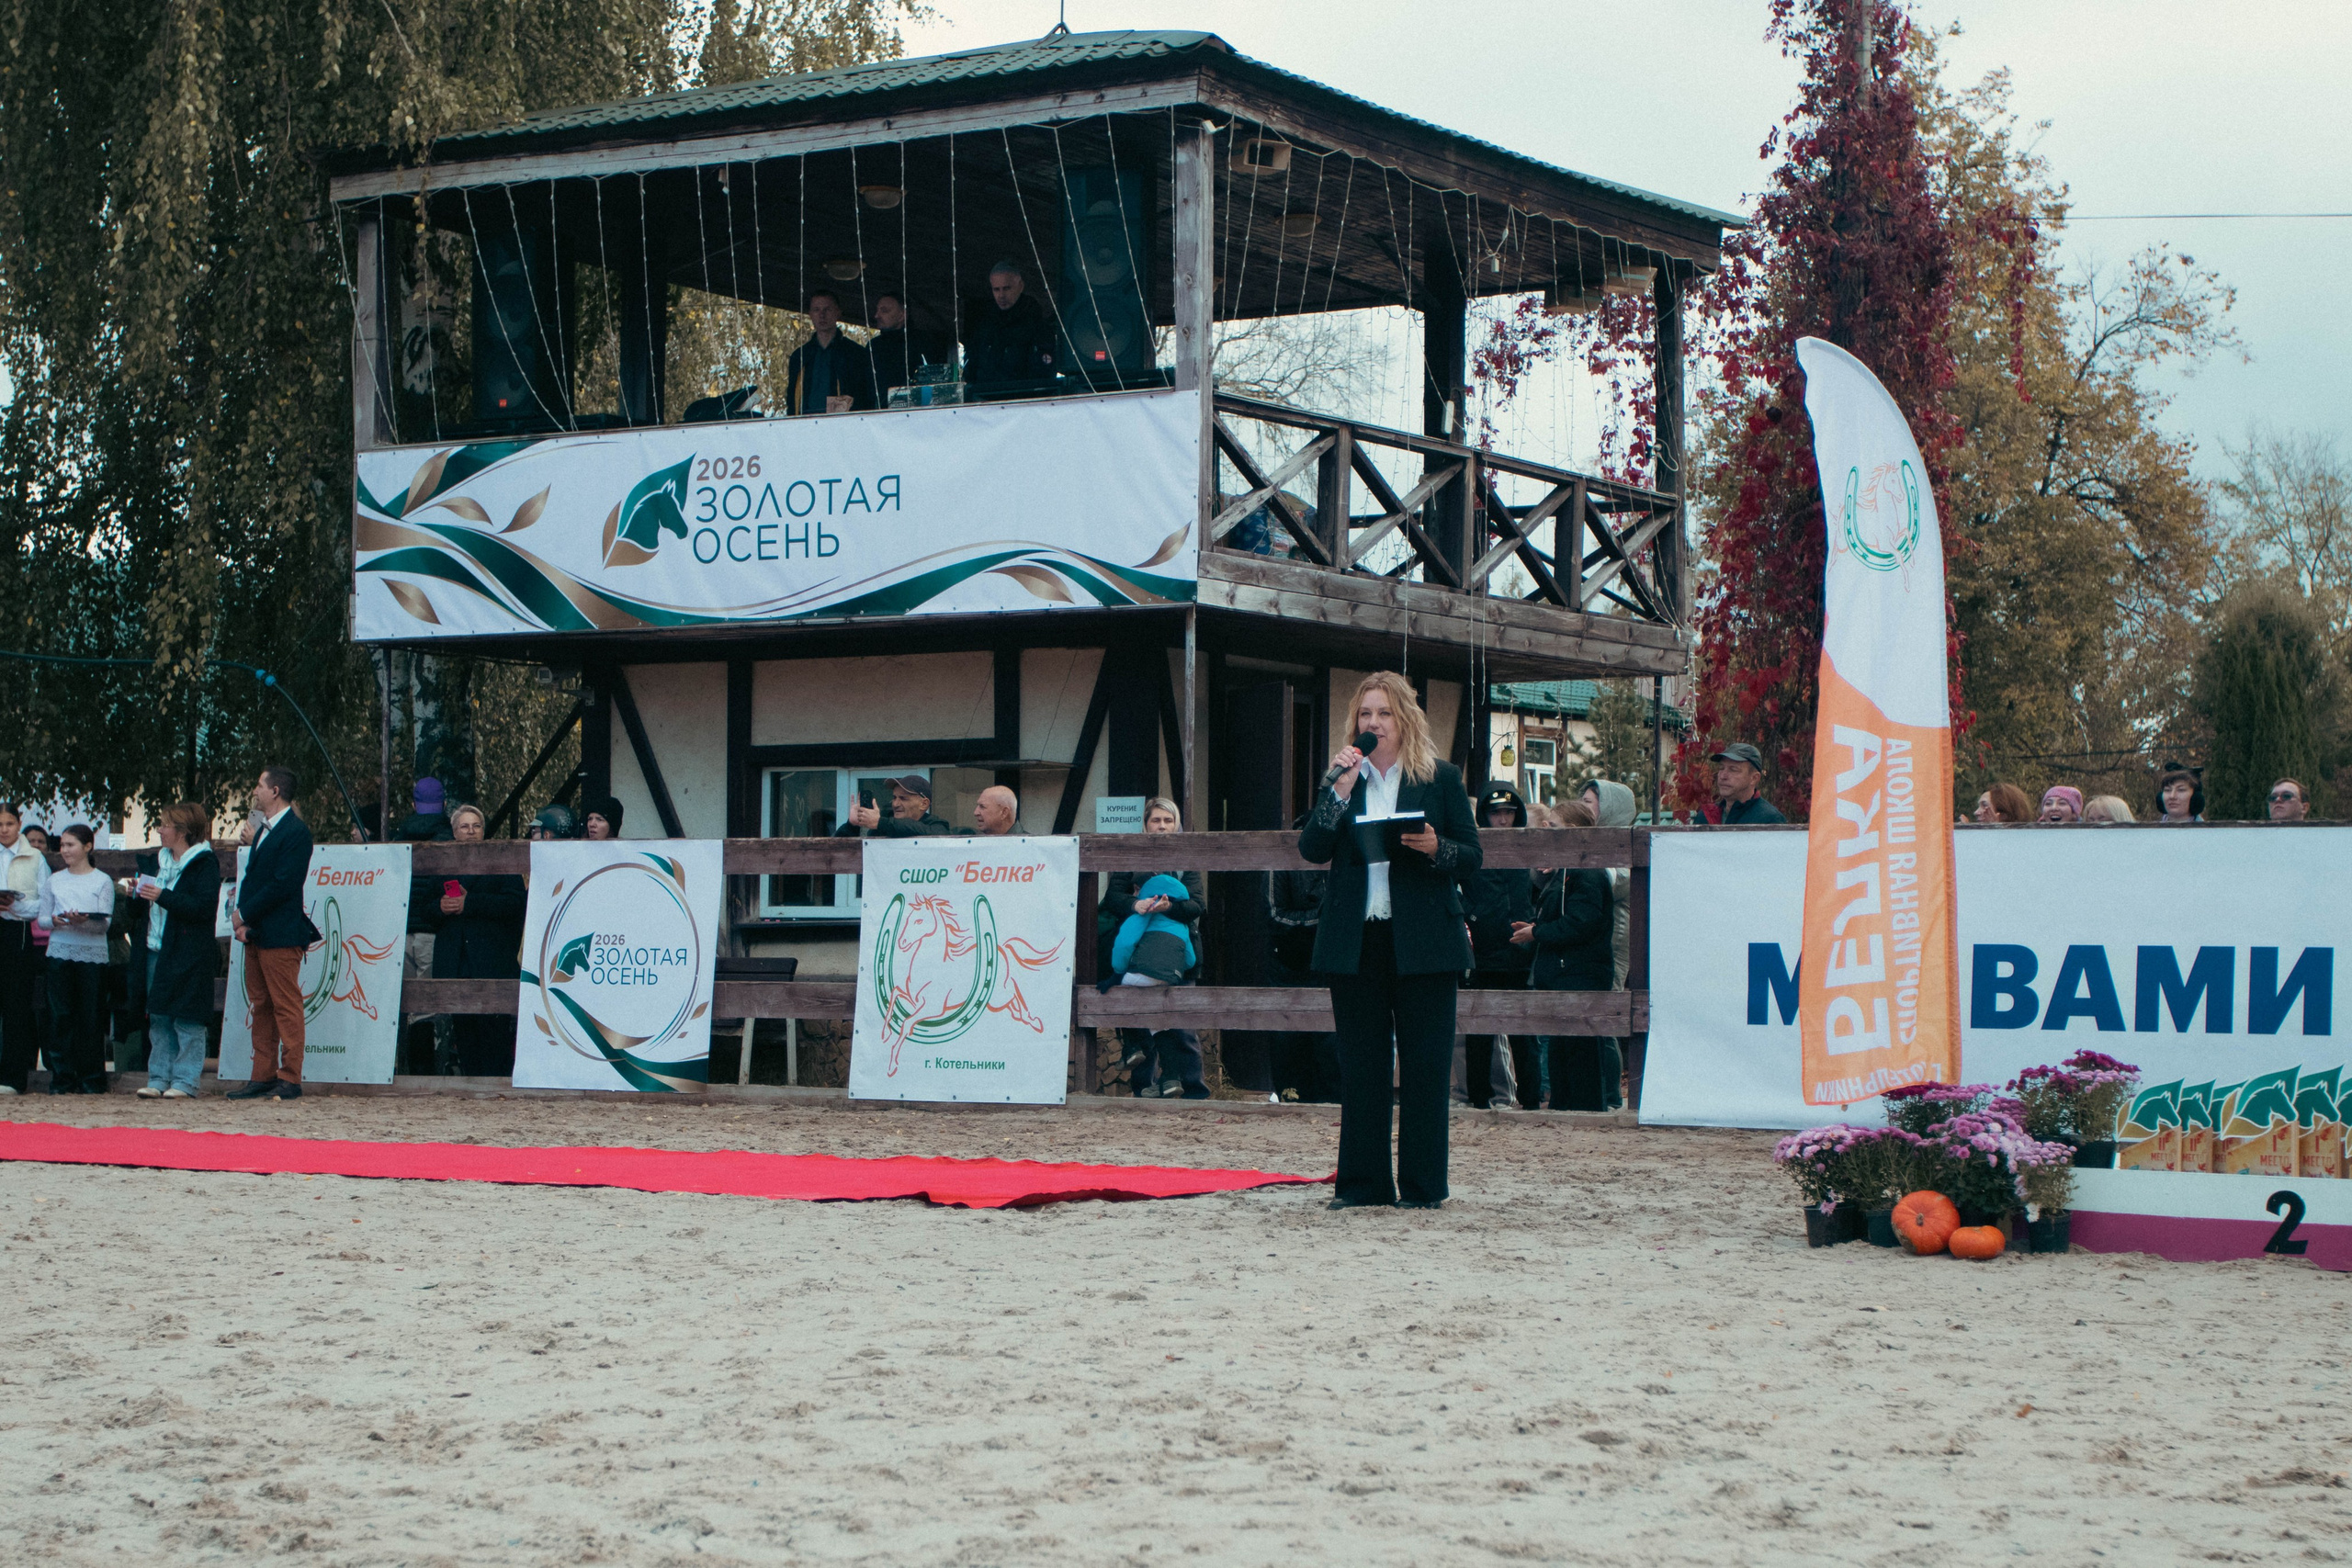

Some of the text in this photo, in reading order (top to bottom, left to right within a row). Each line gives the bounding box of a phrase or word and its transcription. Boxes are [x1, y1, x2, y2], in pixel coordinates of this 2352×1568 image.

[696, 455, 762, 481] 2026
[695, 474, 900, 524] ЗОЛОТАЯ
[693, 521, 840, 564] ОСЕНЬ
[1101, 816, 1142, 824] ЗАПРЕЩЕНО
[899, 868, 949, 884] СШОР
[594, 934, 626, 946] 2026
[594, 947, 688, 966] ЗОЛОТАЯ
[591, 966, 659, 986] ОСЕНЬ
[1970, 943, 2335, 1036] ВАМИ
[924, 1056, 1005, 1070] г. Котельники
[2260, 1155, 2290, 1167] МЕСТО
[2303, 1156, 2333, 1168] МЕСТО
[2263, 1190, 2309, 1255] 2
